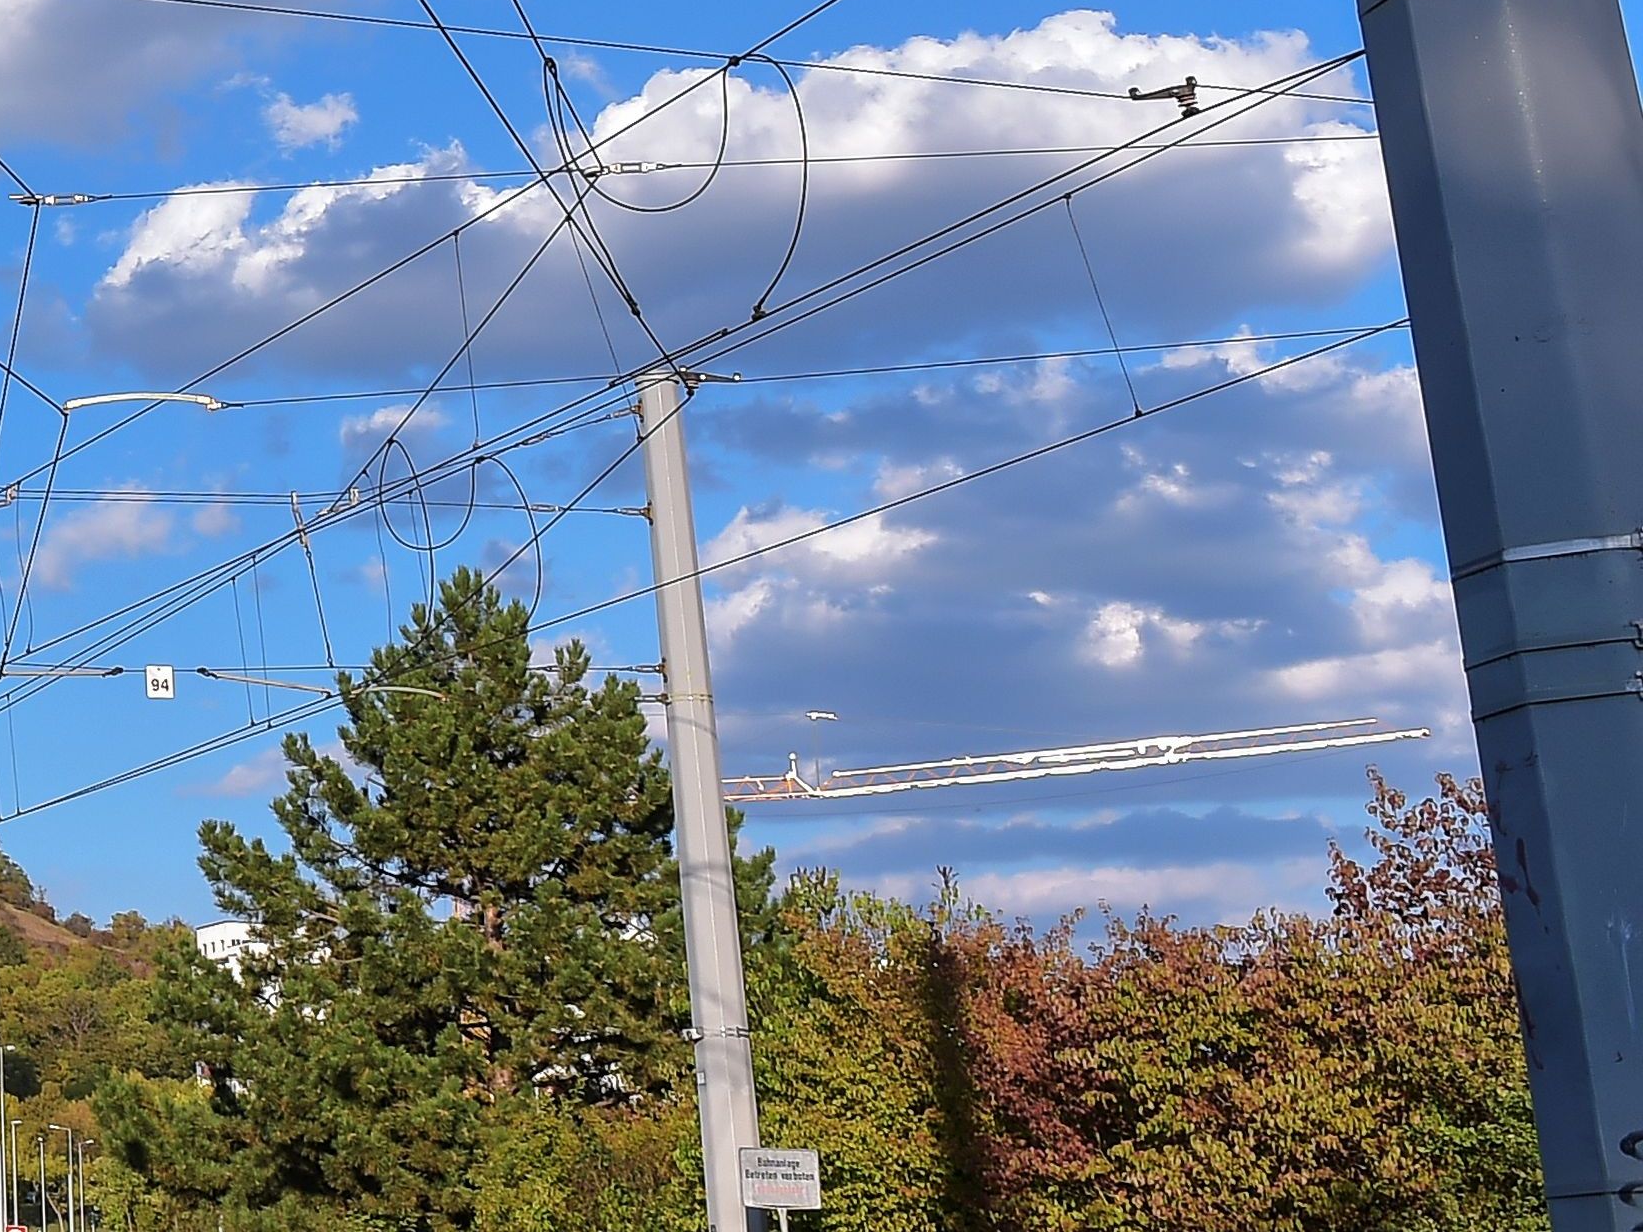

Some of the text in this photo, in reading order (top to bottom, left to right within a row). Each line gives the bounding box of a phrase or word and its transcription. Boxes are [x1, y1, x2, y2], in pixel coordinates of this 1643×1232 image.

[151, 678, 169, 692] 94
[745, 1169, 815, 1181] Betreten verboten
